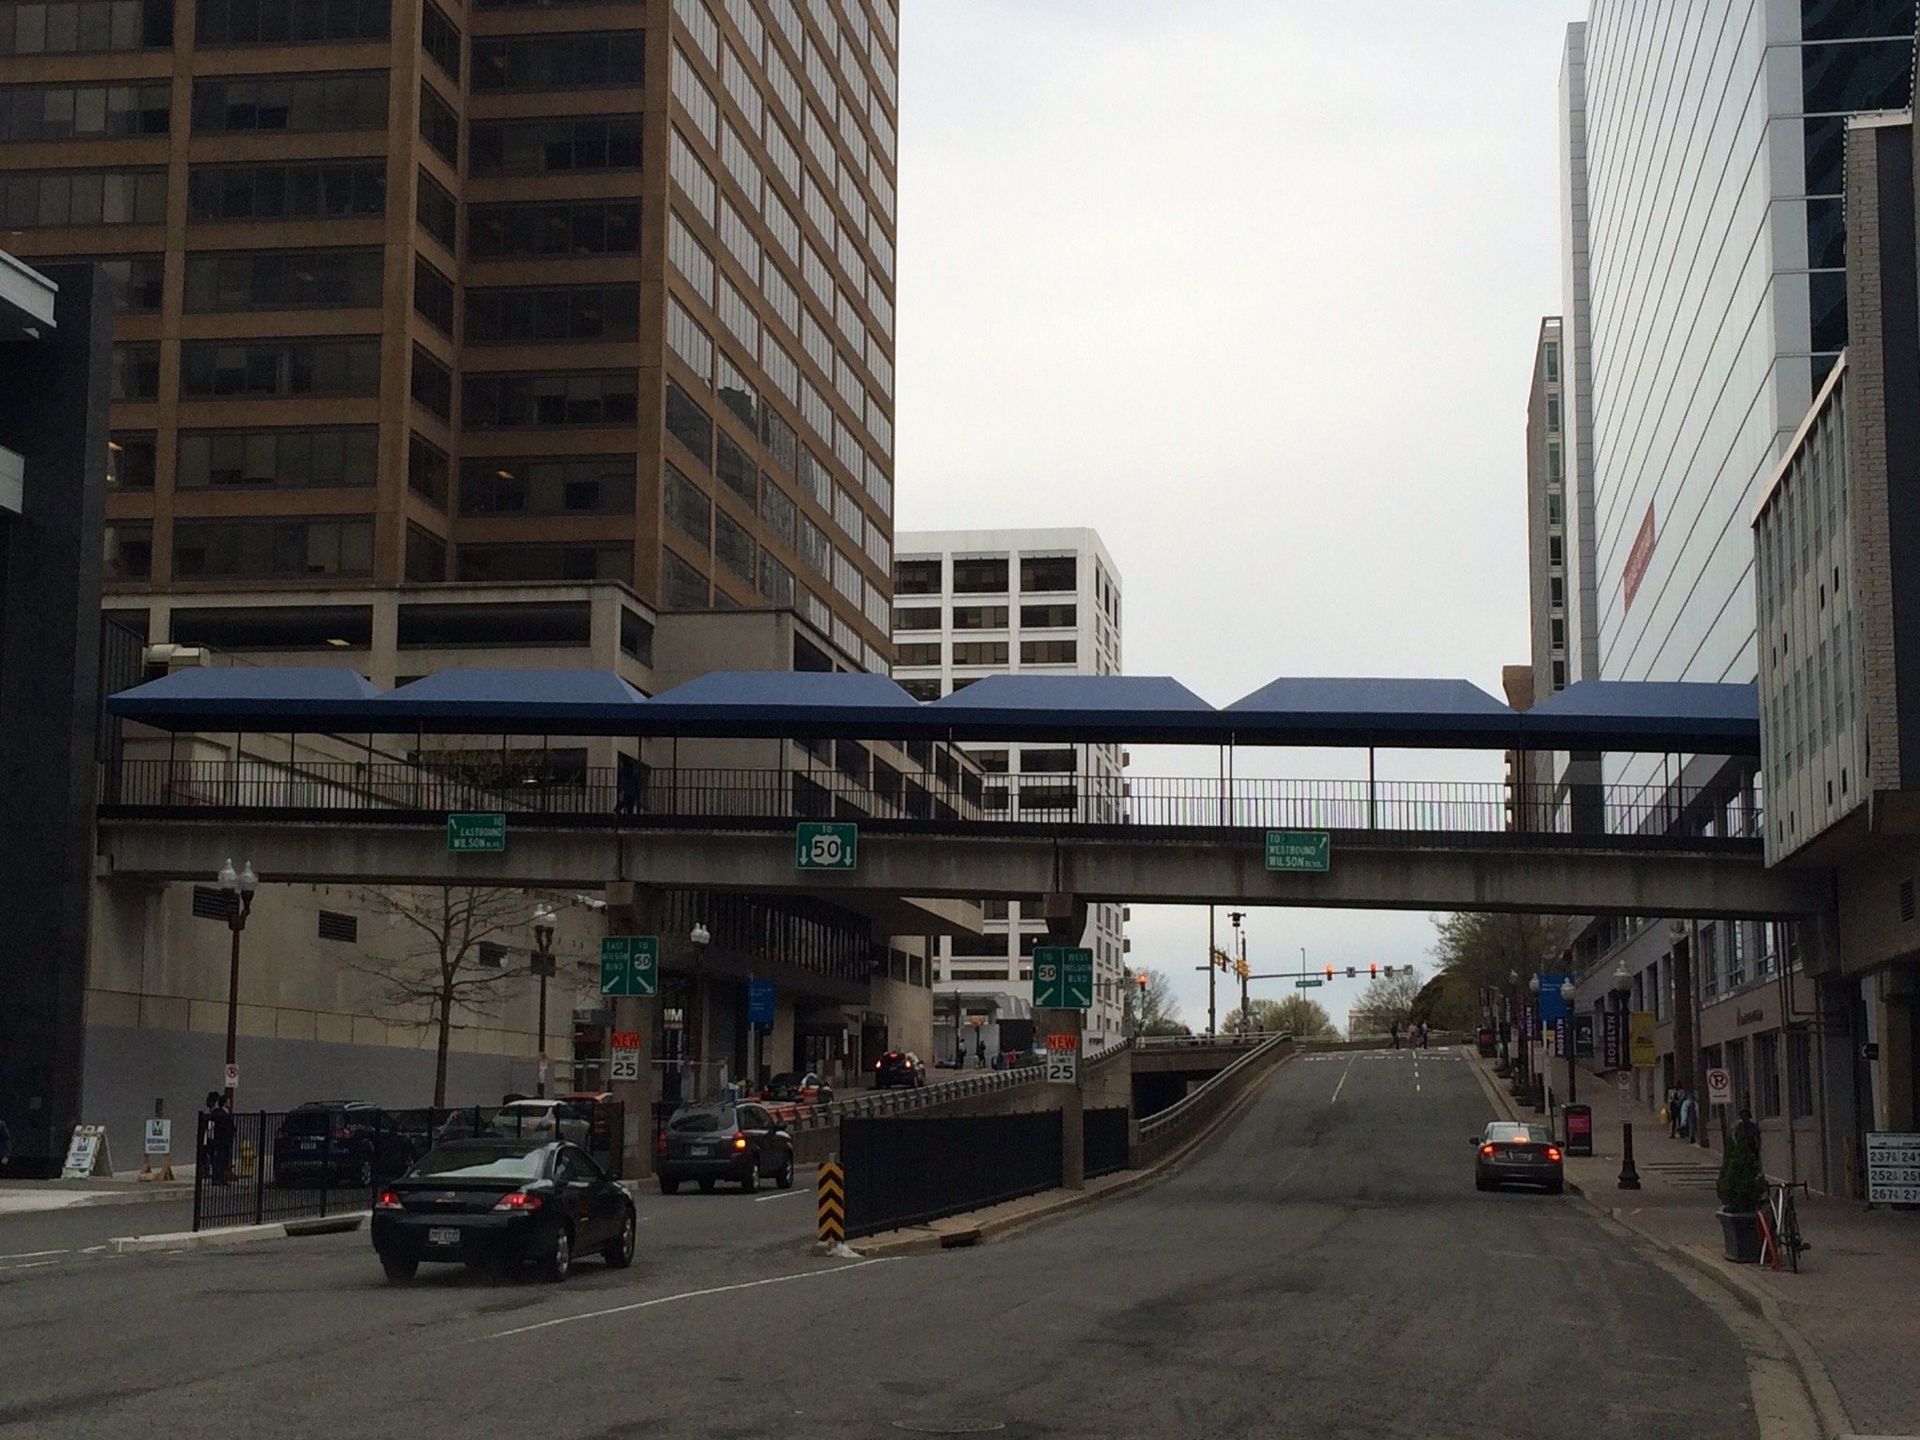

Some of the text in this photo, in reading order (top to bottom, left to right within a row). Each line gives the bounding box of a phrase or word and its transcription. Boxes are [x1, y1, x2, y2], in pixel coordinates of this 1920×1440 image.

[494, 817, 503, 826] TO
[460, 827, 502, 837] EASTBOUND
[822, 825, 832, 833] TO
[454, 838, 485, 848] WILSON
[1269, 834, 1280, 843] TO
[813, 840, 840, 858] 50
[1269, 846, 1315, 855] WESTBOUND
[1269, 856, 1304, 867] WILSON
[635, 955, 650, 966] 50
[1040, 967, 1055, 977] 50
[613, 1033, 640, 1047] NEW
[1048, 1036, 1076, 1048] NEW
[1556, 1018, 1564, 1055] ROSSLYN
[1607, 1015, 1617, 1063] ROSSLYN
[613, 1063, 636, 1076] 25
[1050, 1065, 1073, 1079] 25
